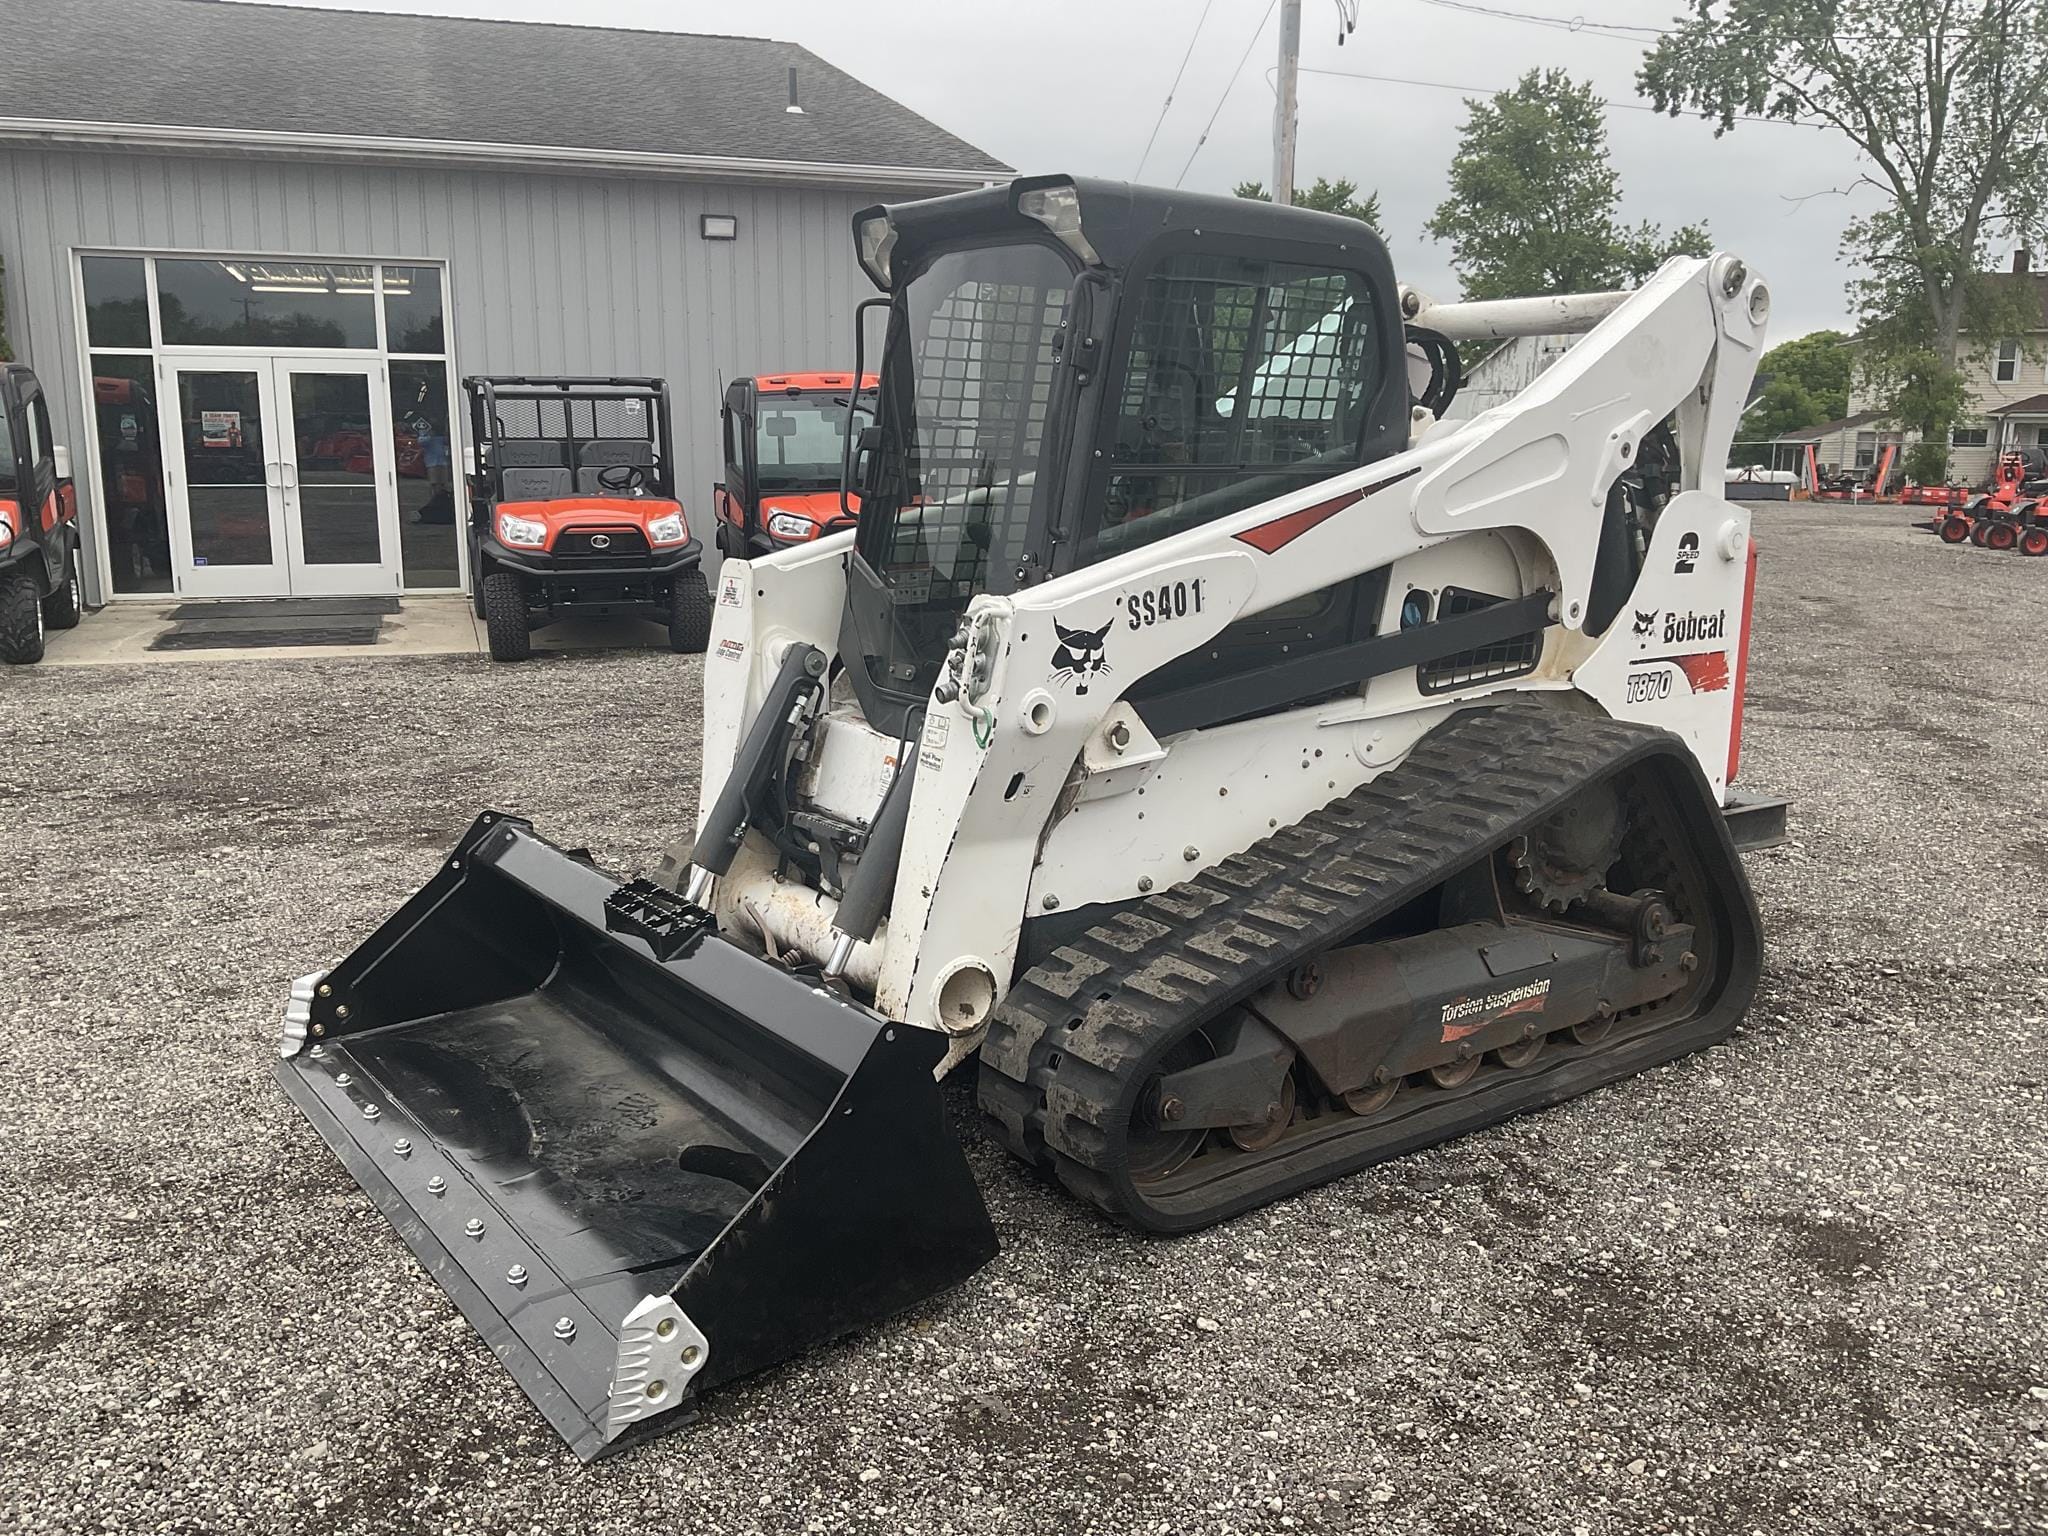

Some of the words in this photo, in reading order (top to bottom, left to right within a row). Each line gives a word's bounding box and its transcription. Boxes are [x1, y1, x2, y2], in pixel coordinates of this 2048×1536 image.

[1674, 532, 1700, 574] 2
[1676, 551, 1700, 560] SPEED
[1128, 578, 1201, 631] SS401
[1663, 609, 1725, 644] Bobcat
[1627, 670, 1673, 704] T870
[1441, 998, 1484, 1023] Torsion
[1485, 978, 1551, 1008] Suspension
